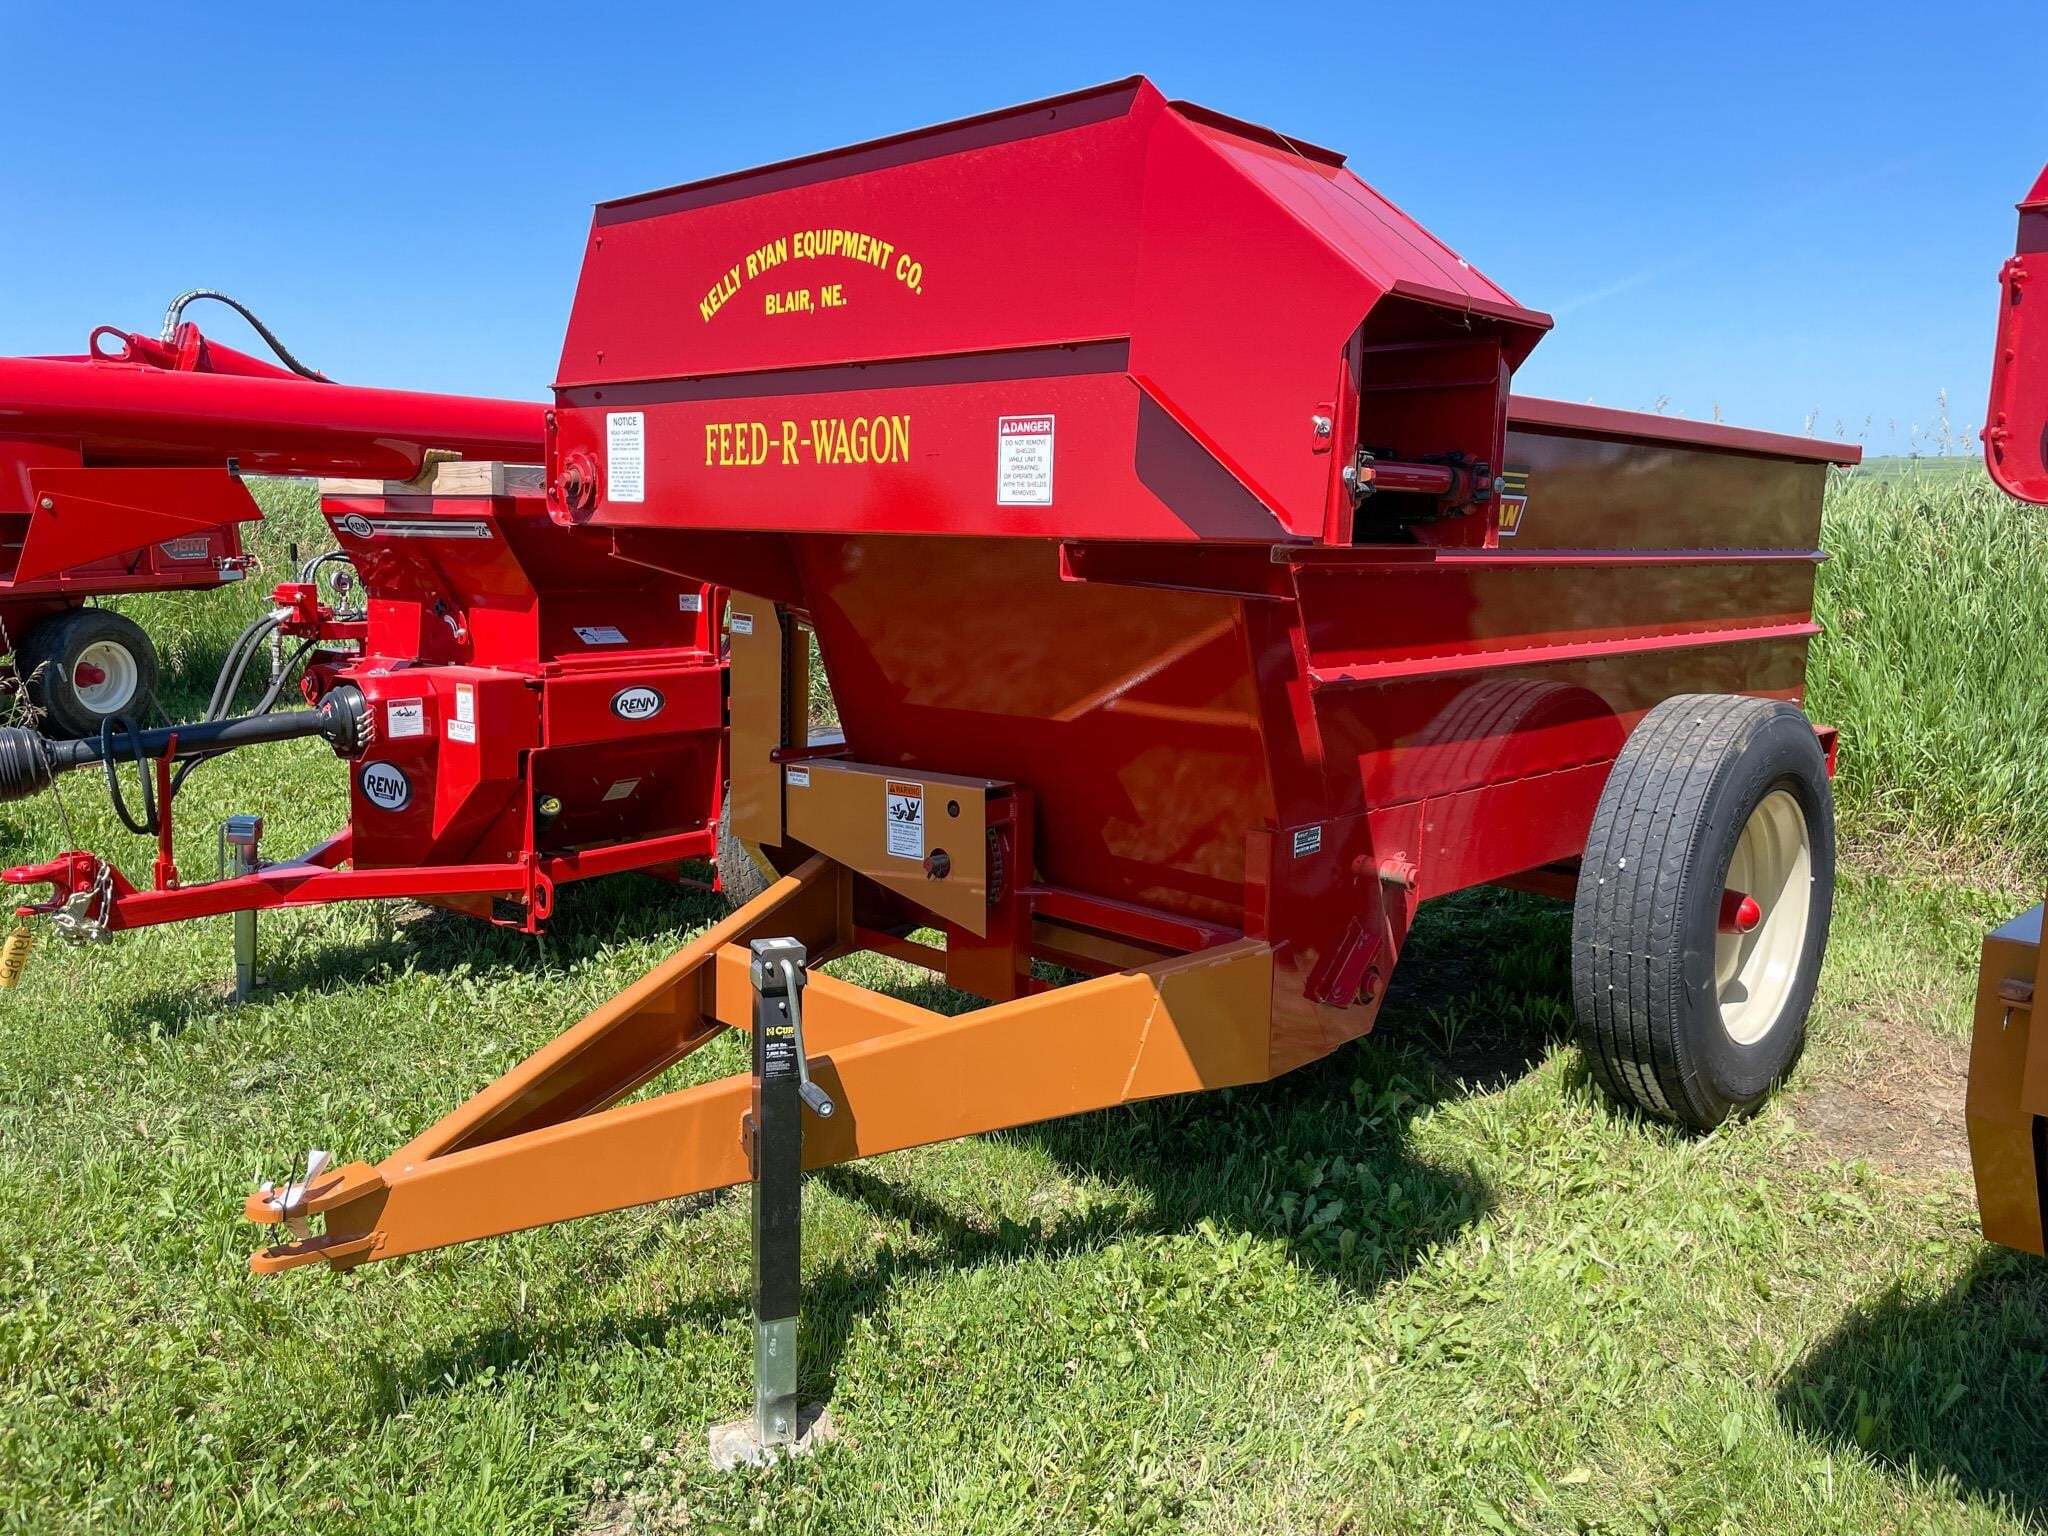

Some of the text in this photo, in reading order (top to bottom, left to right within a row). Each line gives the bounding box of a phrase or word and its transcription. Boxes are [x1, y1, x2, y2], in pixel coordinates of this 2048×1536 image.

[699, 229, 923, 323] KELLY RYAN EQUIPMENT CO.
[765, 284, 848, 315] BLAIR, NE.
[613, 416, 637, 426] NOTICE
[1010, 421, 1050, 432] DANGER
[705, 415, 911, 466] FEED-R-WAGON
[620, 696, 656, 713] RENN
[367, 774, 404, 800] RENN
[775, 1026, 794, 1035] CUR
